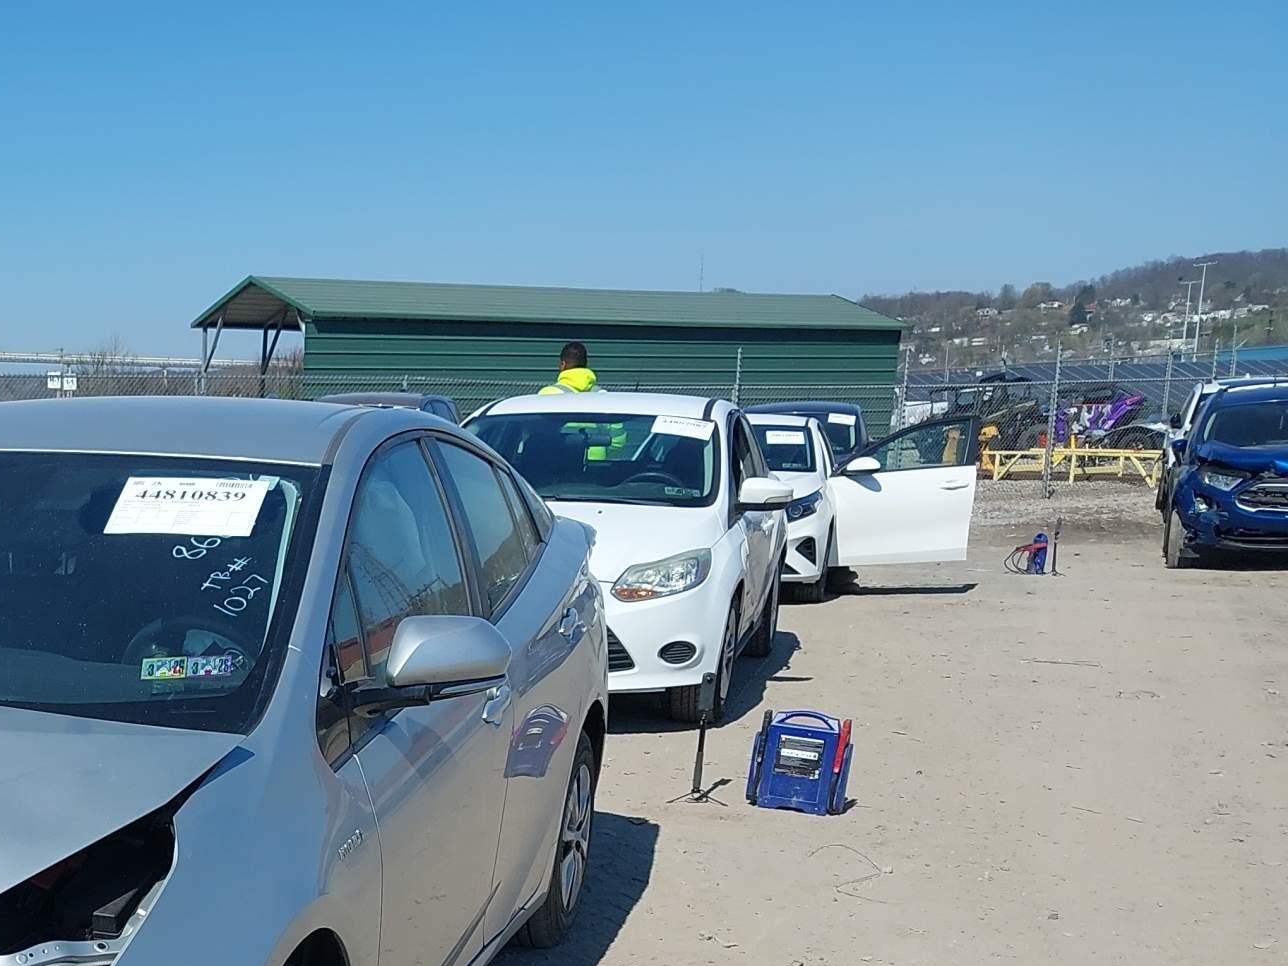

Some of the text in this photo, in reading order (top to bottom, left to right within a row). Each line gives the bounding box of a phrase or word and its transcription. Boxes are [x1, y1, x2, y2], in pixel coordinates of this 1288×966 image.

[134, 489, 246, 502] 44810839
[213, 574, 269, 617] 1027
[148, 663, 154, 677] 3
[192, 662, 199, 675] 3
